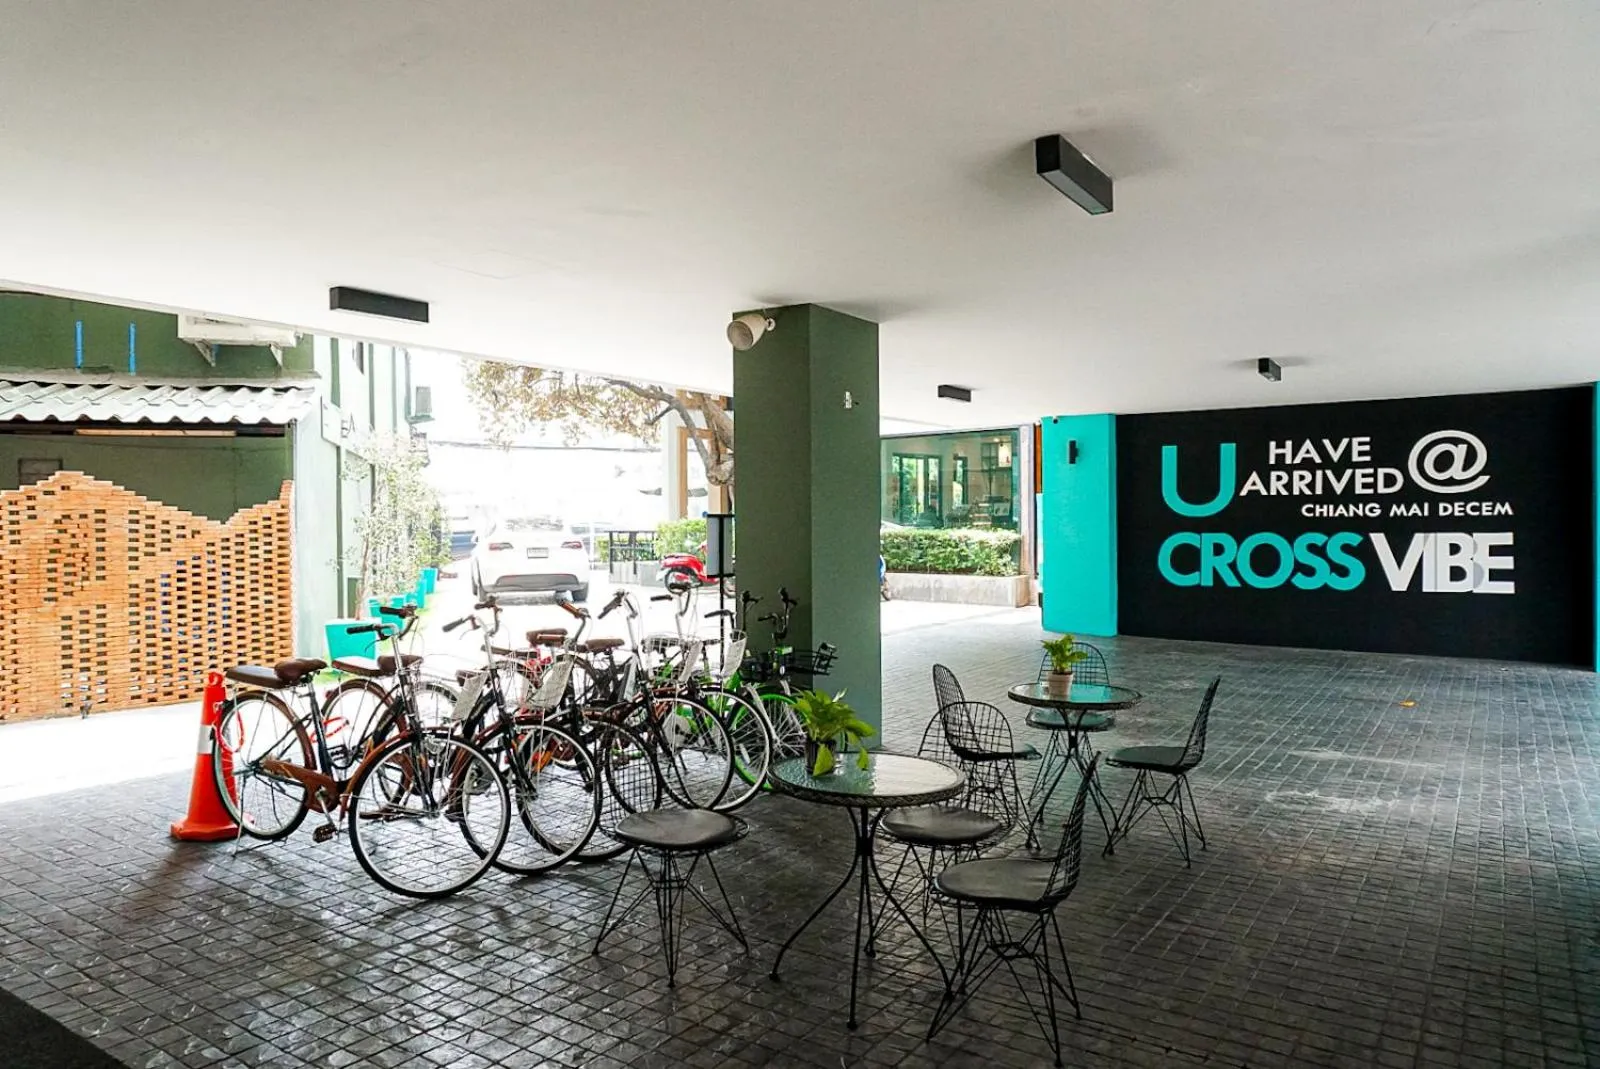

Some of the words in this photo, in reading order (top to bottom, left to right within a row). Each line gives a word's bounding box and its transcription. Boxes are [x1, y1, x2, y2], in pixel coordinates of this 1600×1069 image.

[1161, 442, 1237, 517] U
[1239, 467, 1405, 497] ARRIVED
[1407, 429, 1491, 494] @
[1268, 436, 1372, 465] HAVE
[1301, 502, 1382, 518] CHIANG
[1389, 502, 1429, 518] MAI
[1438, 501, 1514, 517] DECEM
[1157, 531, 1366, 591] CROSS
[1368, 531, 1516, 595] VIBE
